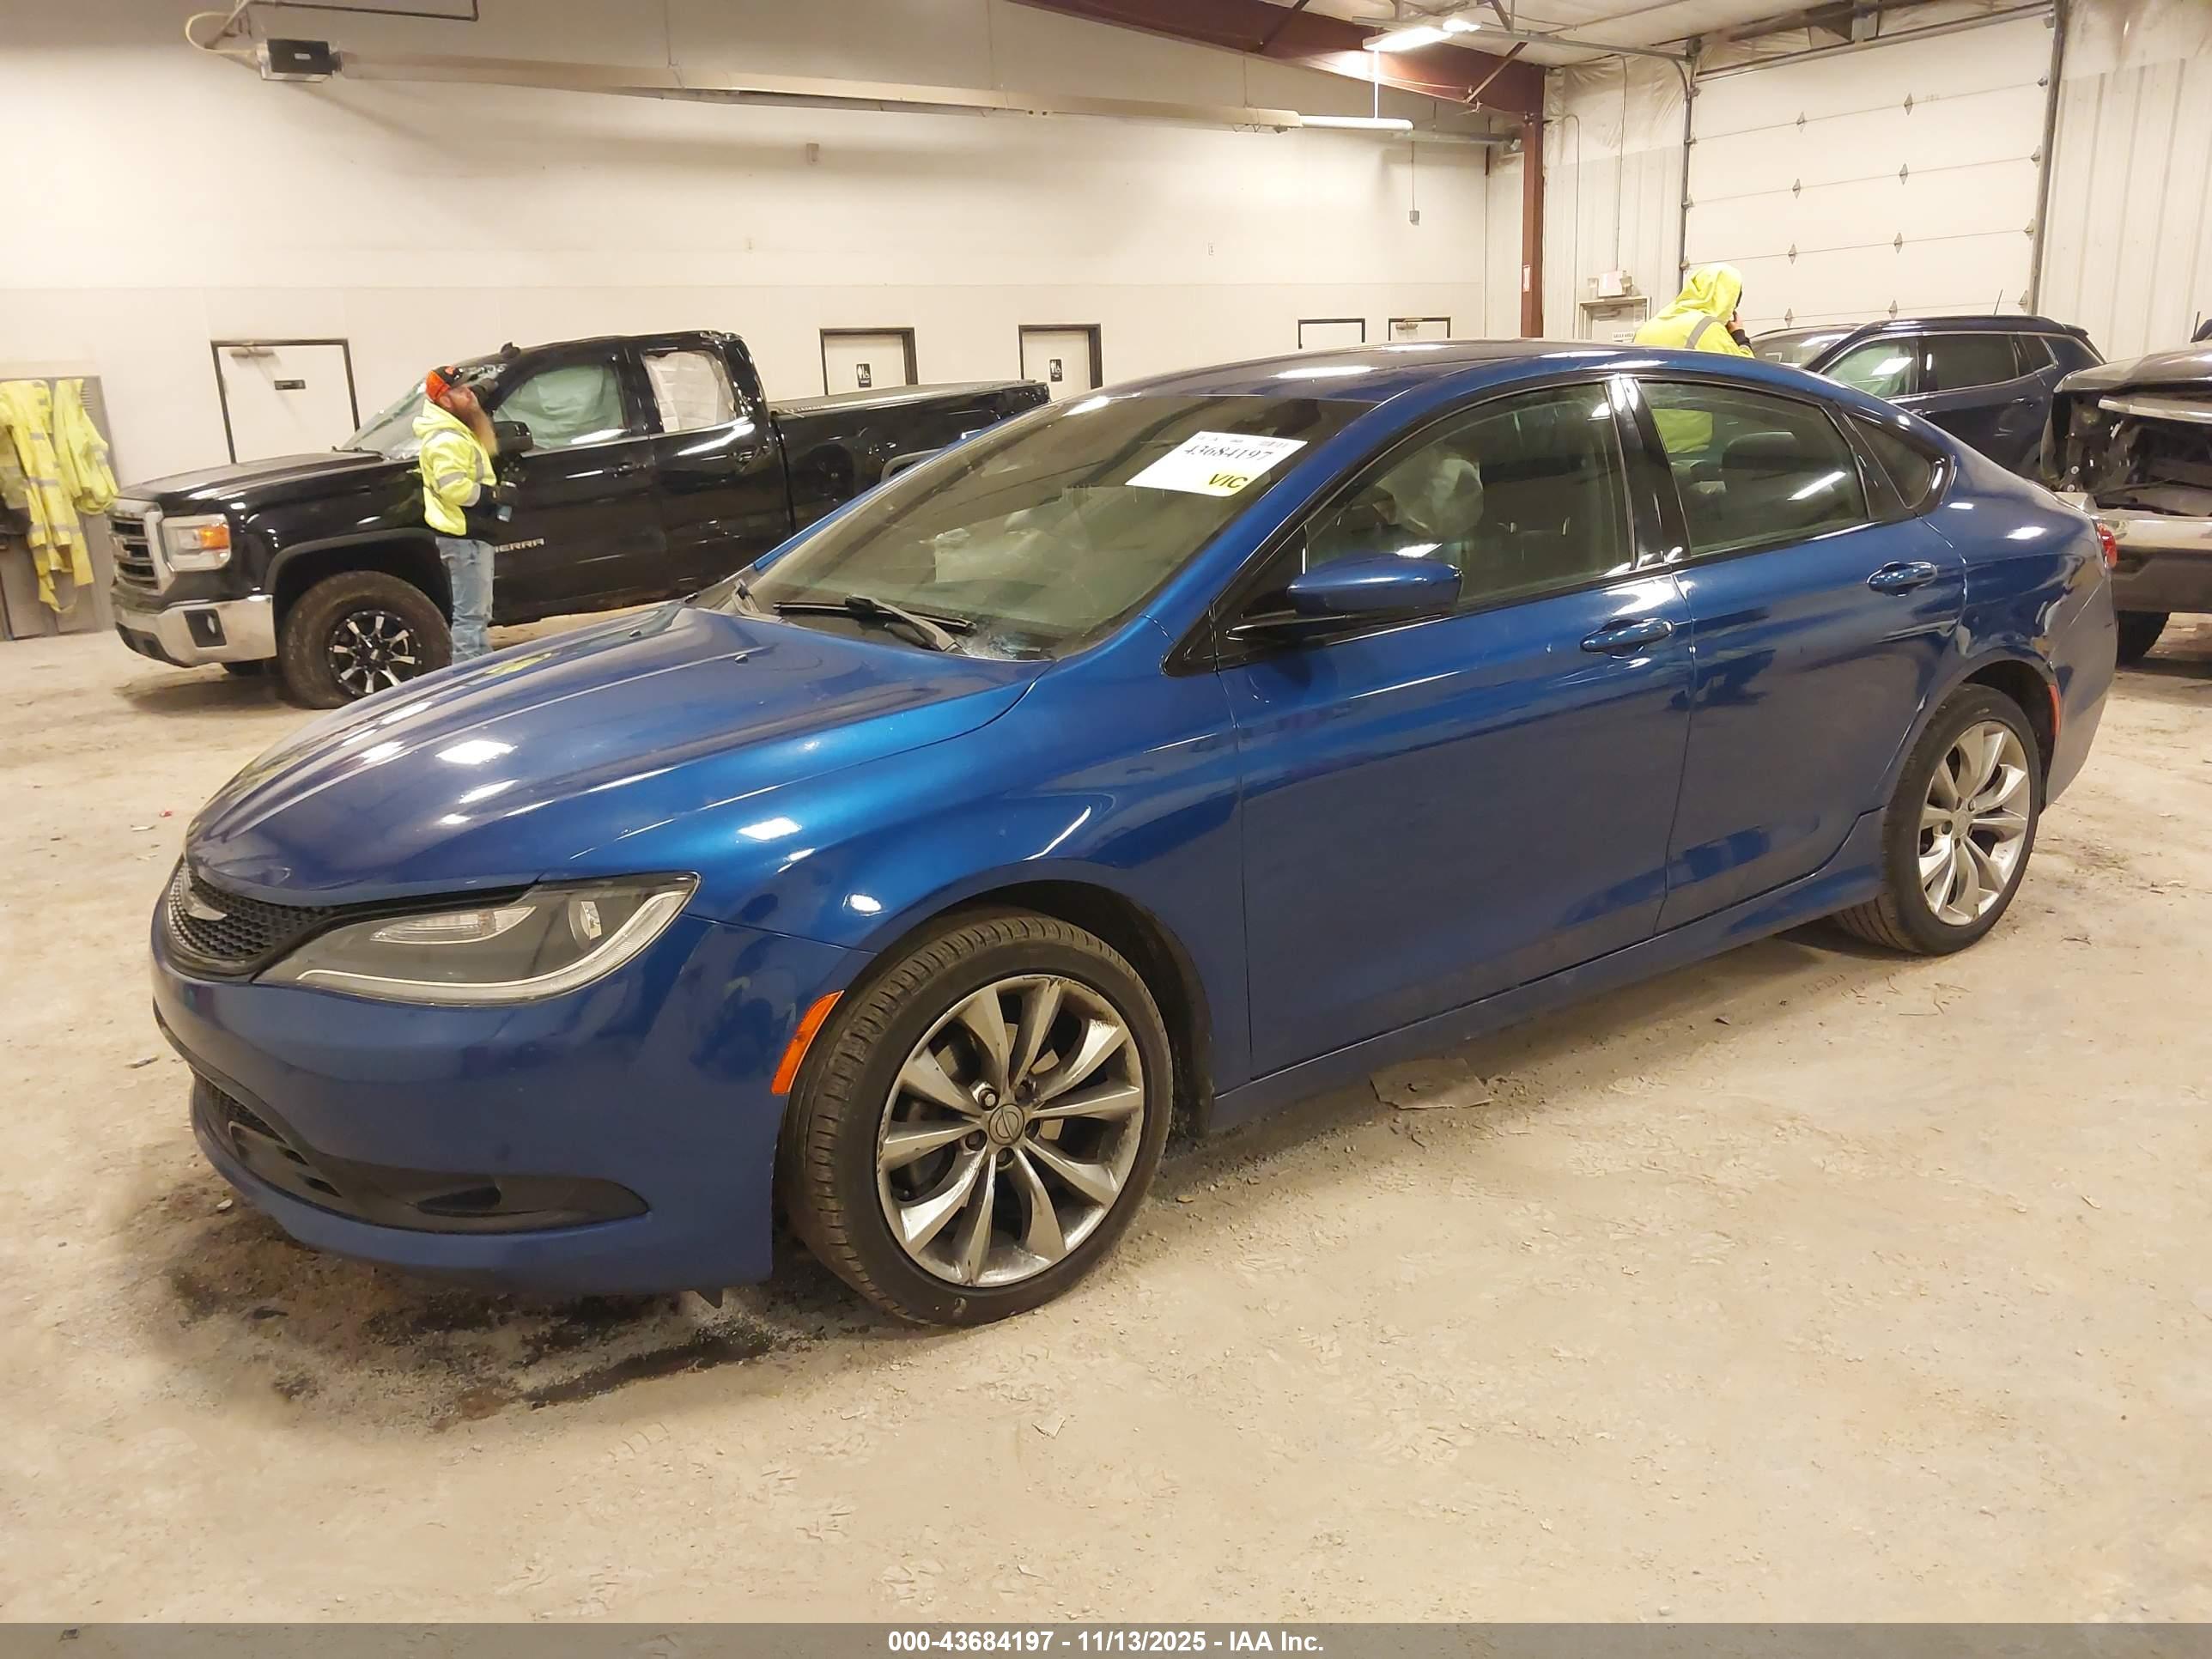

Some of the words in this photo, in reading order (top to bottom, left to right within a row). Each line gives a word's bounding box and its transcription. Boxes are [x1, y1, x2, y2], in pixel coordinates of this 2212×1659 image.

[1185, 445, 1273, 460] 43684197
[1209, 473, 1249, 489] VIC
[495, 538, 545, 553] IERRA
